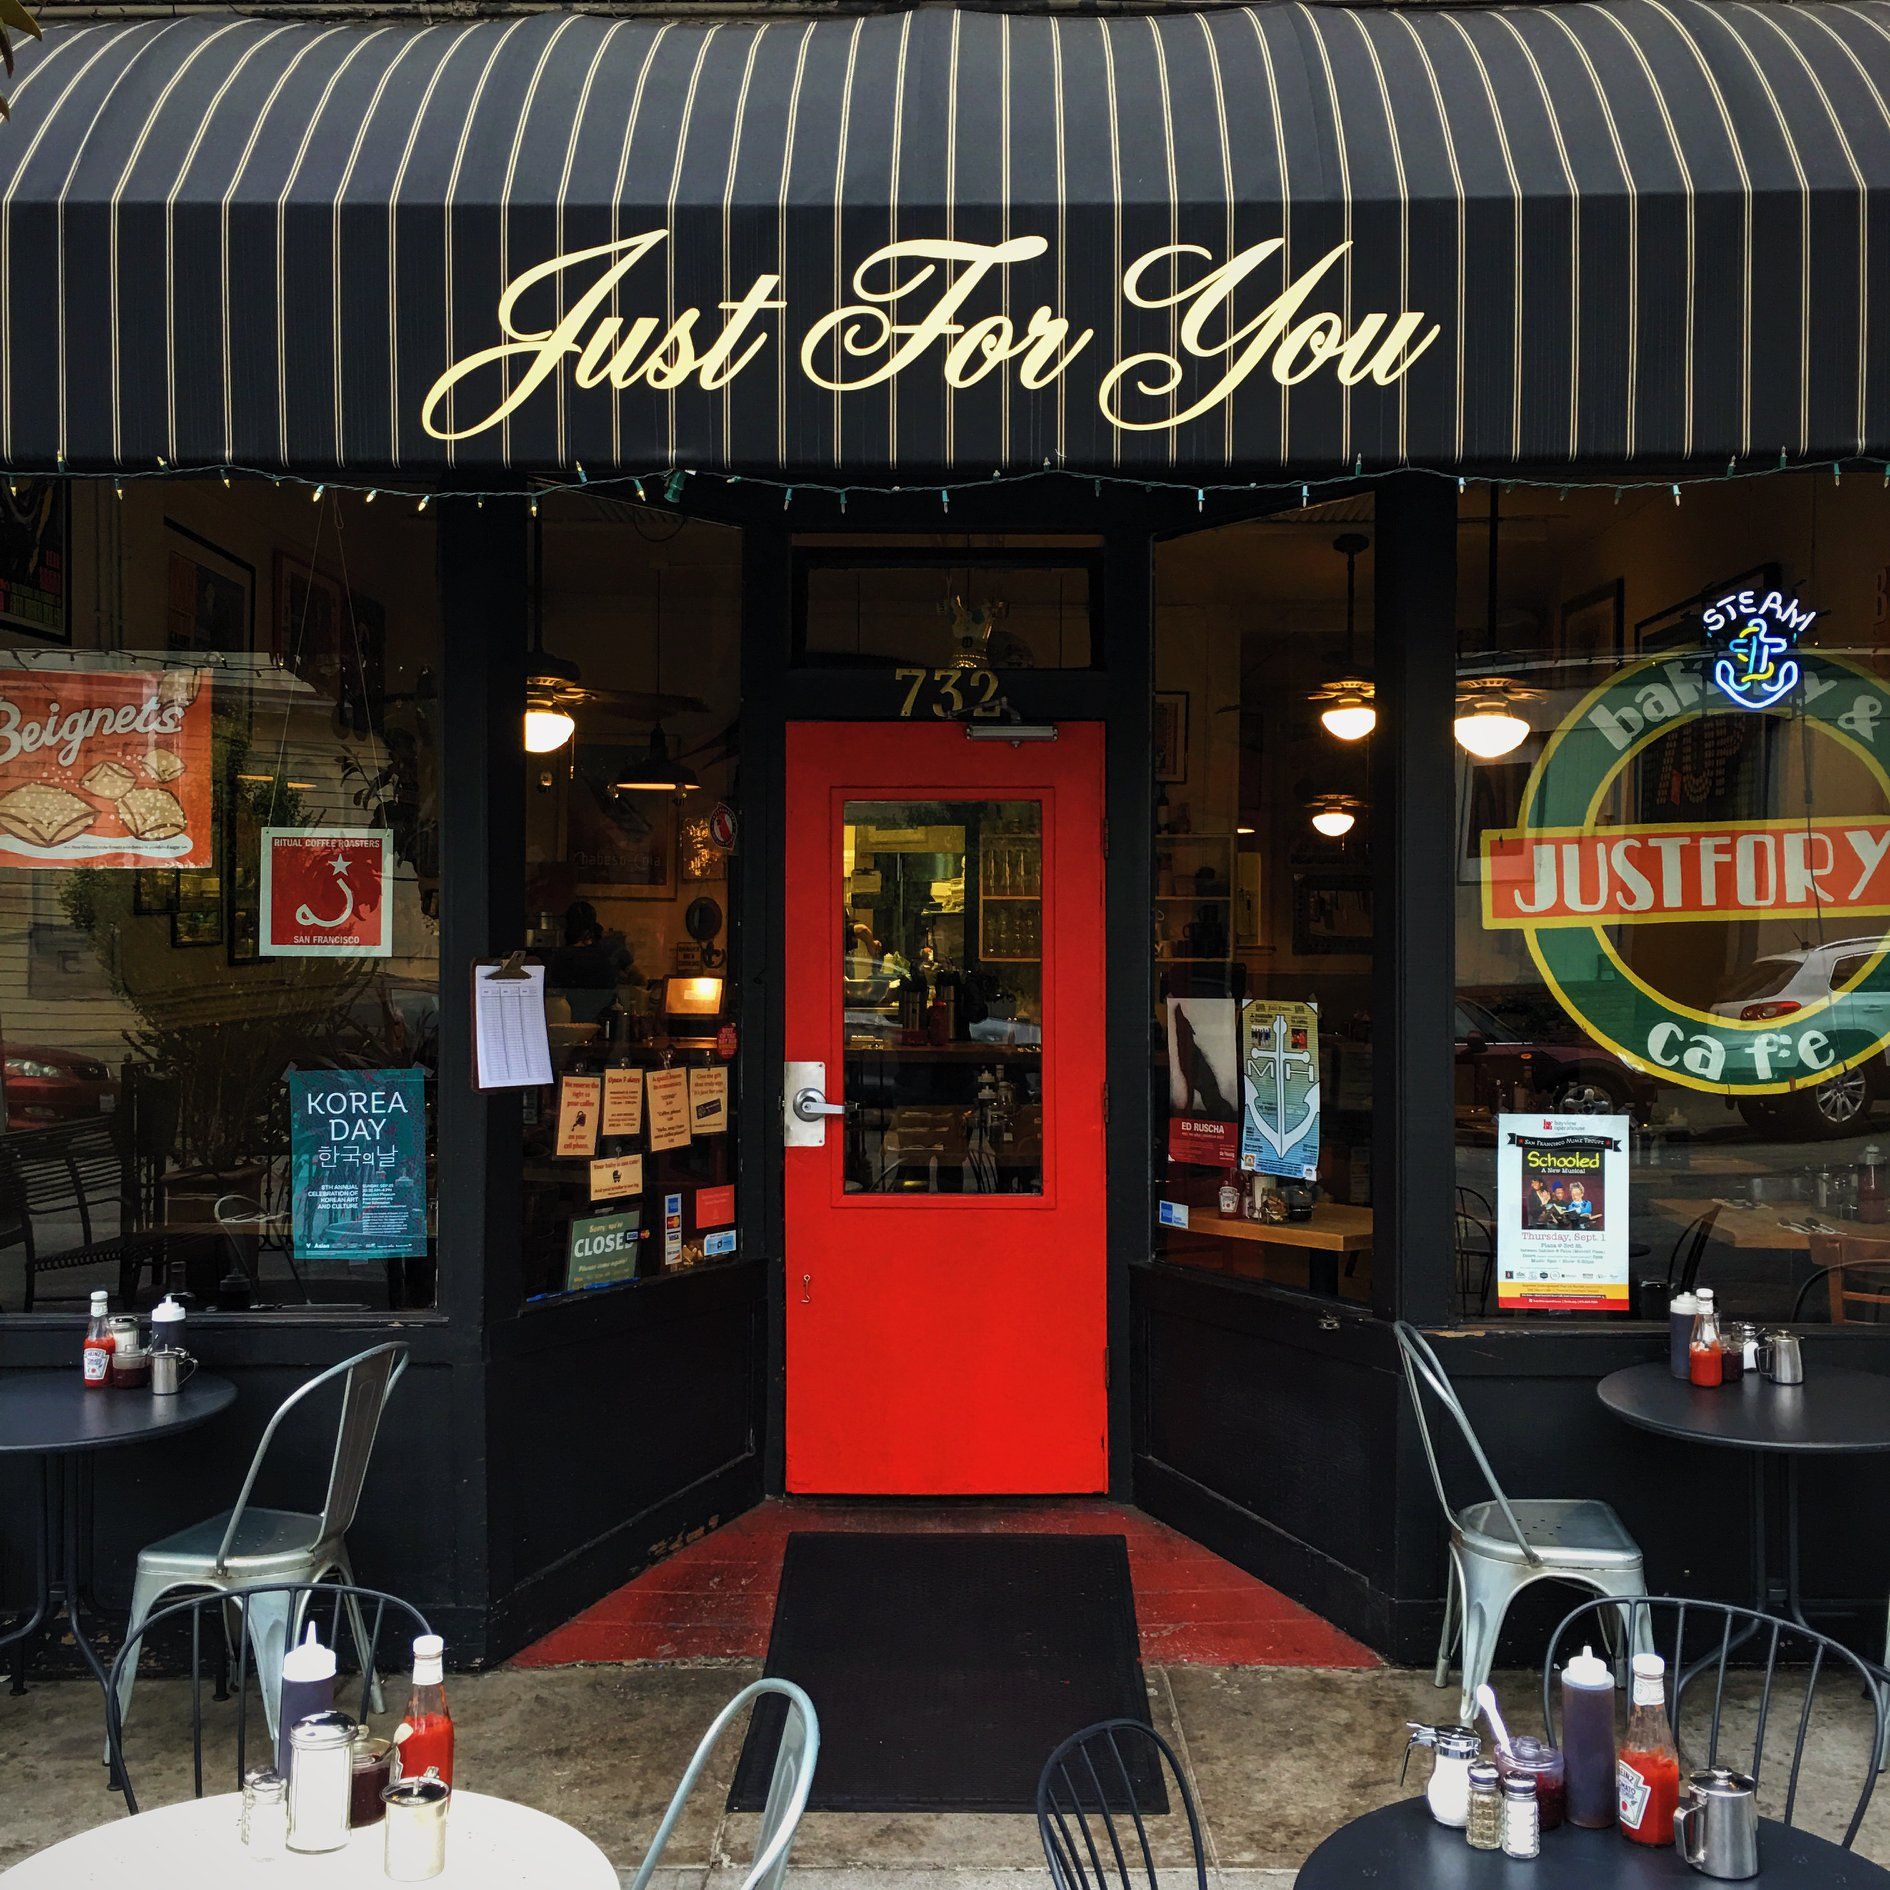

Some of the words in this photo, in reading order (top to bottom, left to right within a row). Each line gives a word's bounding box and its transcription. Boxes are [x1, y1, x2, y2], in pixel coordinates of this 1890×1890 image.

[422, 229, 787, 440] Just
[801, 235, 1093, 390] For
[1099, 237, 1441, 431] You
[1703, 591, 1816, 631] STEAM
[895, 668, 1000, 717] 732
[0, 696, 185, 767] Beignets
[274, 839, 302, 847] RITUAL
[305, 839, 336, 848] COFFEE
[338, 839, 380, 848] ROASTERS
[293, 935, 311, 944] SAN
[313, 935, 360, 944] FRANCISCO
[608, 1076, 622, 1084] Open
[627, 1076, 641, 1084] days
[307, 1091, 408, 1115] KOREA
[328, 1118, 387, 1141] DAY
[1181, 1121, 1192, 1131] ED
[1193, 1122, 1225, 1134] RUSCHA
[317, 1144, 399, 1168] 한국의날
[1527, 1151, 1600, 1169] Schooled
[1521, 1232, 1571, 1242] Thursday,
[1601, 1233, 1606, 1241] 1
